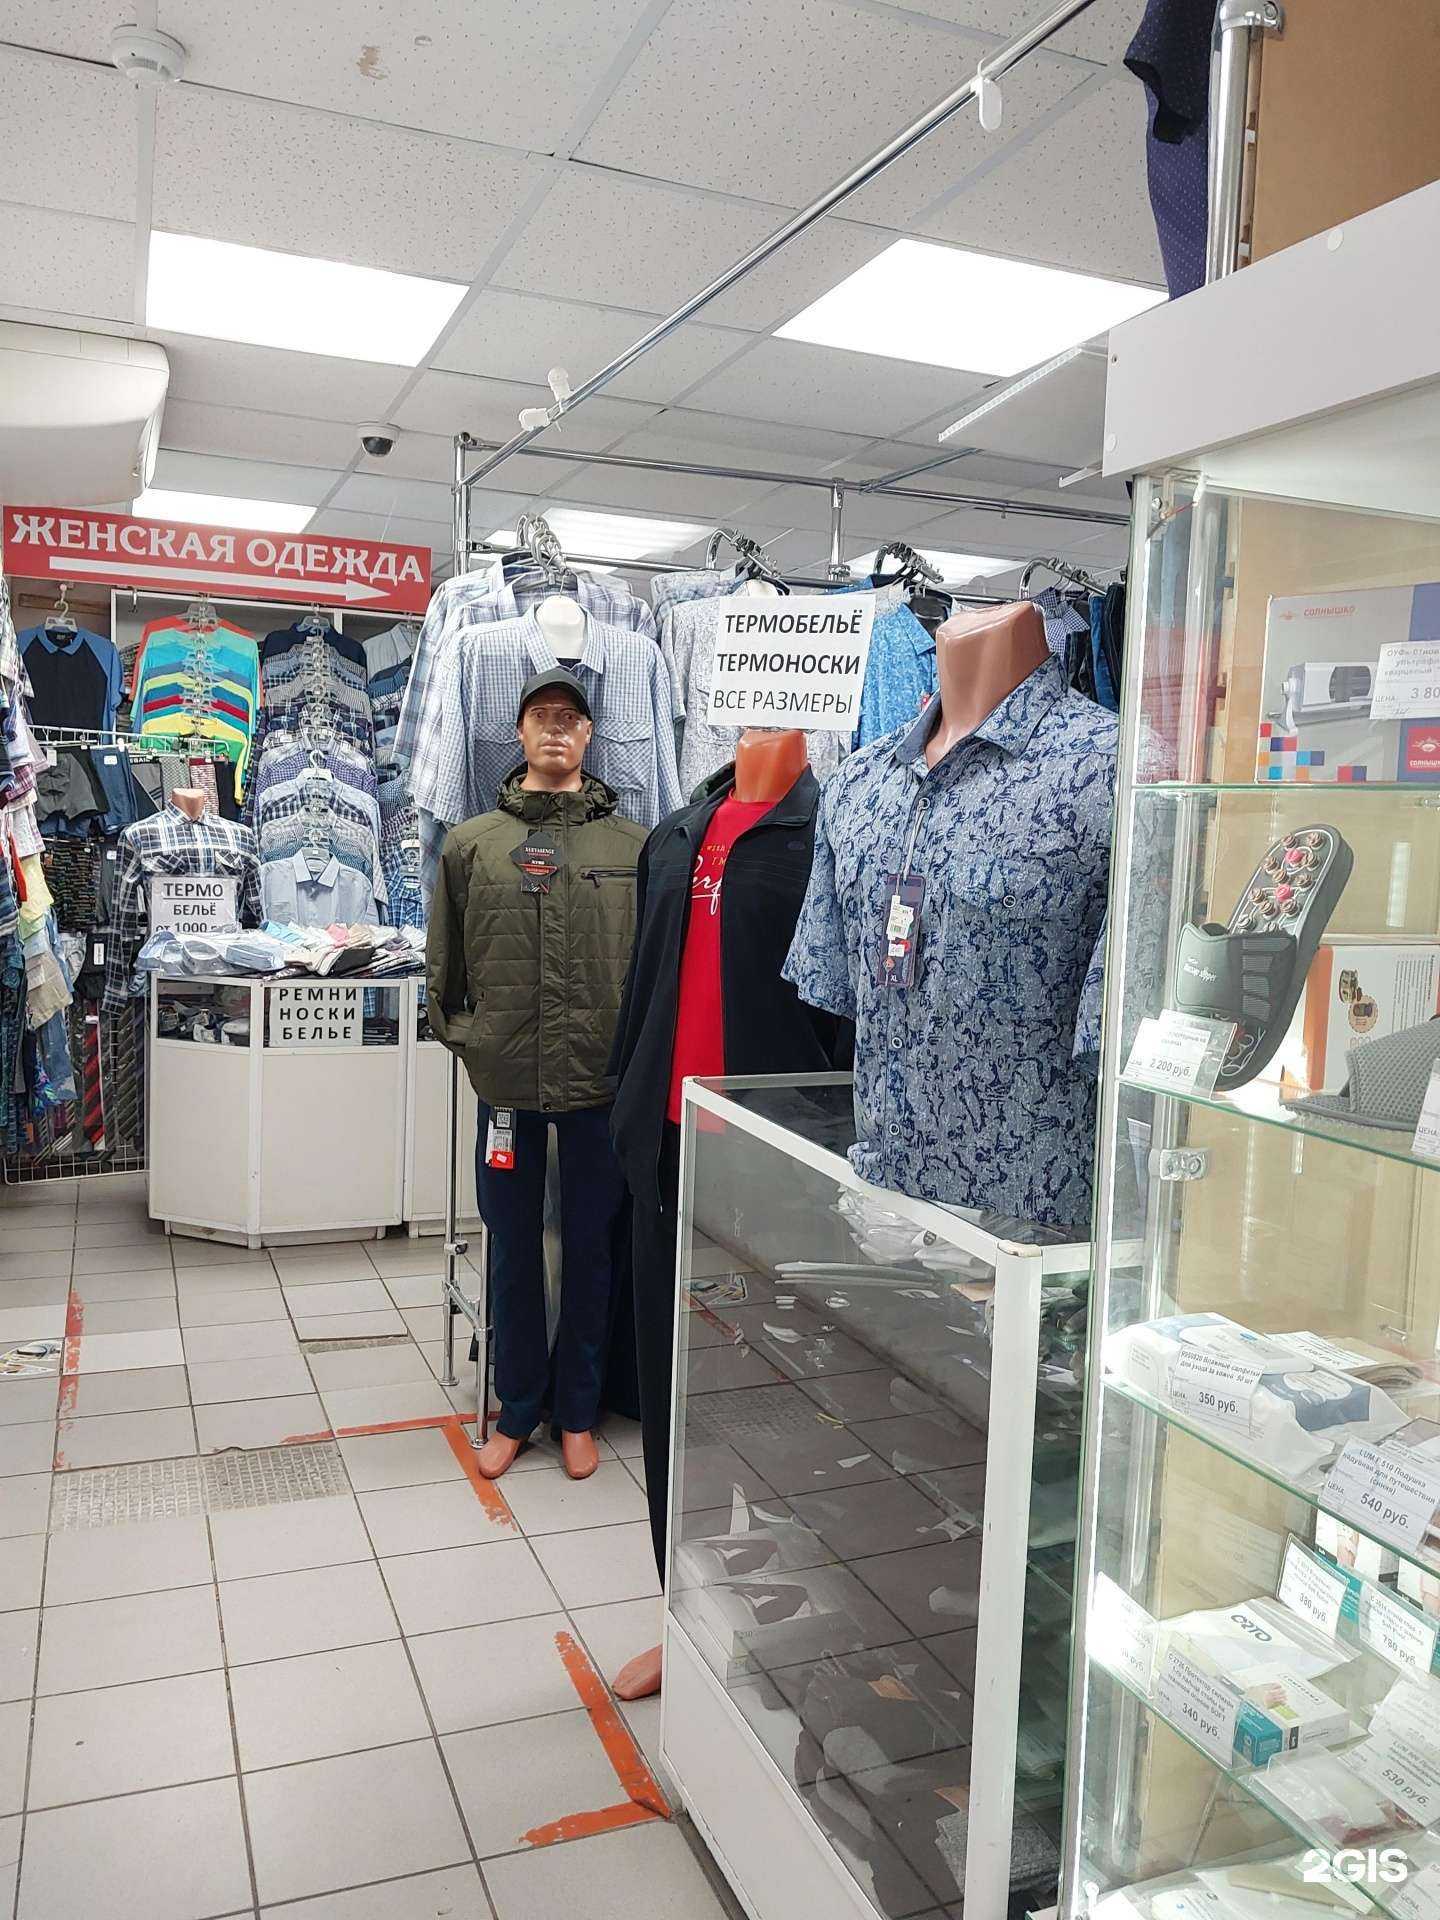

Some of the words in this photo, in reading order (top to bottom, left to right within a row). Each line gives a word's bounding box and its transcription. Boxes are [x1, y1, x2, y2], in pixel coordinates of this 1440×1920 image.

[11, 514, 235, 564] ЖЕНСКАЯ
[246, 538, 425, 587] ОДЕЖДА
[725, 609, 863, 634] ТЕРМОБЕЛЬЁ
[717, 653, 860, 675] ТЕРМОНОСКИ
[713, 689, 747, 709] ВСЕ
[752, 690, 853, 714] РАЗМЕРЫ
[1410, 687, 1420, 699] 3
[163, 883, 223, 897] ТЕРМО
[173, 902, 217, 916] БЕЛЬЁ
[175, 922, 208, 933] 1000
[279, 988, 357, 1001] РЕМНИ
[279, 1007, 355, 1020] НОСКИ
[283, 1026, 352, 1040] БЕЛЬЕ
[1156, 1060, 1173, 1074] 200
[1199, 1391, 1215, 1407] 350
[1217, 1400, 1239, 1414] руб.
[1327, 1480, 1345, 1495] ЦЕНА
[1360, 1492, 1383, 1513] 540
[1382, 1508, 1409, 1529] руб.
[1182, 1702, 1198, 1722] 340
[1200, 1719, 1221, 1740] руб.
[1381, 1768, 1405, 1787] 530
[1401, 1785, 1430, 1808] руб.
